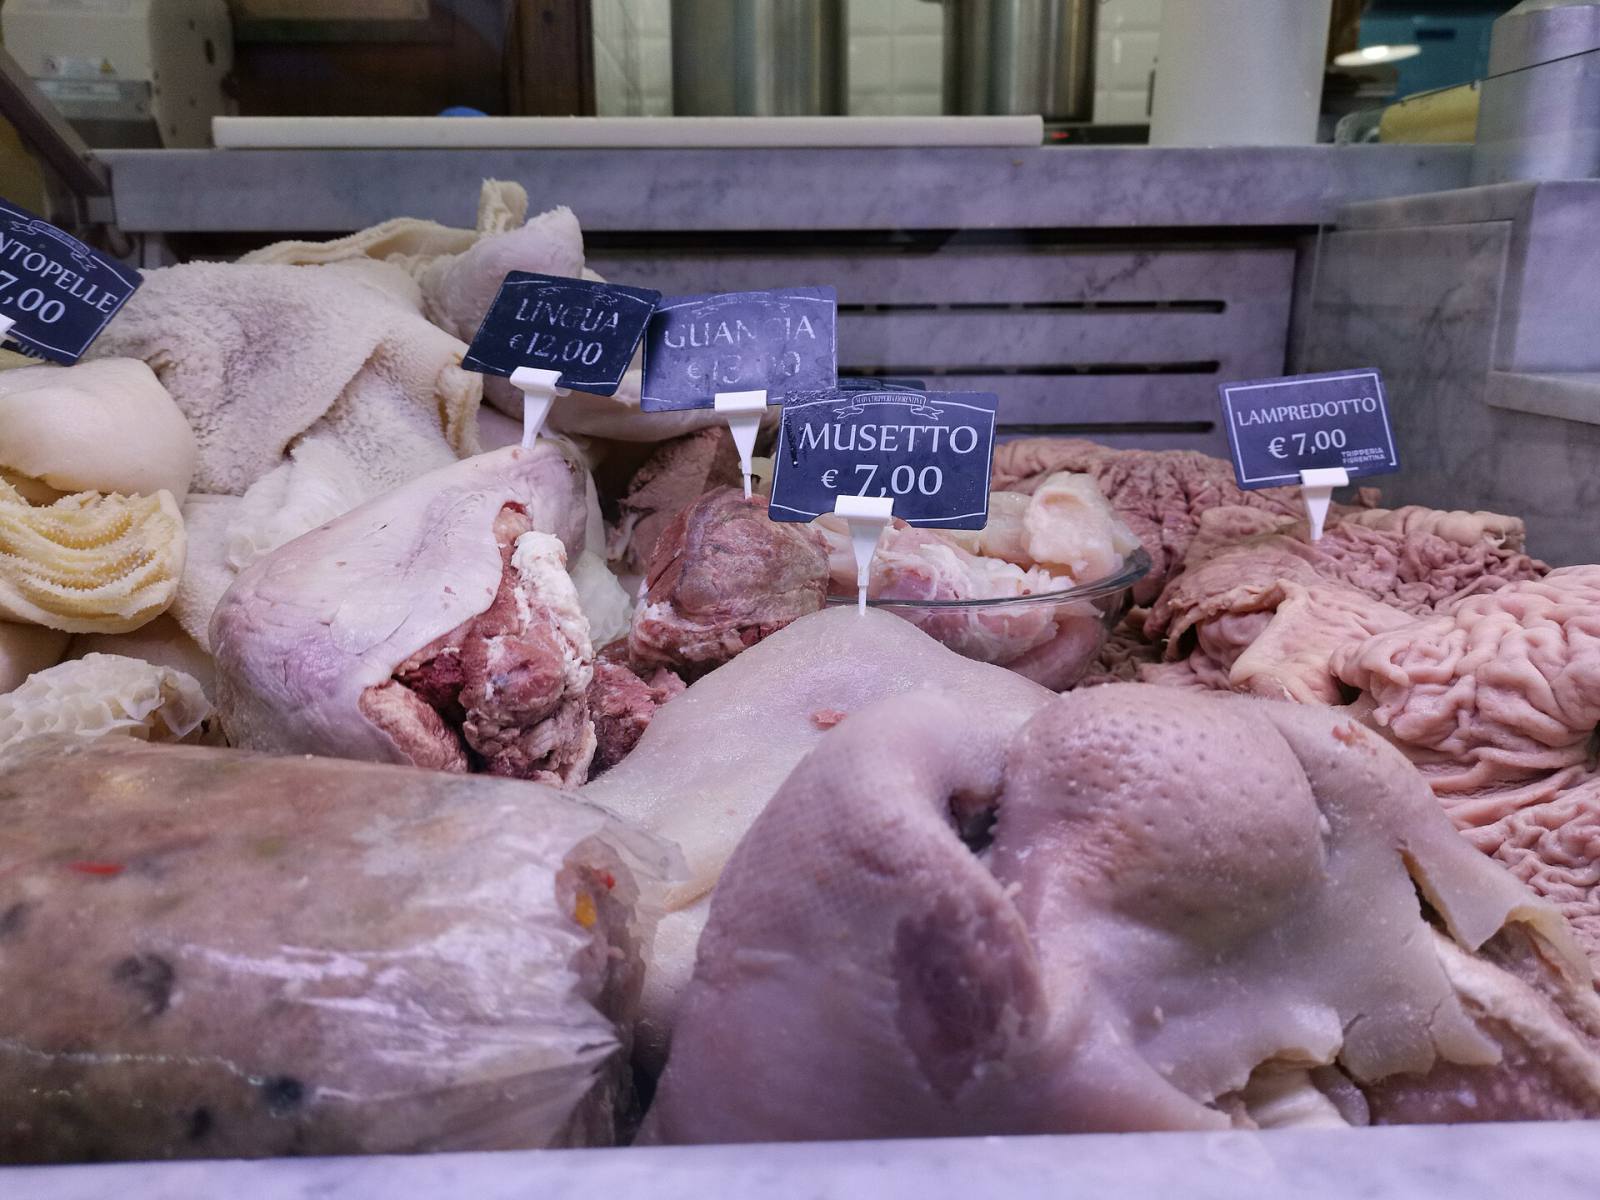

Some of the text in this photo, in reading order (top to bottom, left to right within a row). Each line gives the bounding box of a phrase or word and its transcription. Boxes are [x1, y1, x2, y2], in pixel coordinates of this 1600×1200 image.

[515, 298, 619, 335] LINGUA
[1237, 397, 1377, 427] LAMPREDOTTO
[798, 422, 979, 454] MUSETTO
[1267, 428, 1347, 459] € 7,00
[1341, 447, 1385, 458] TRIPPERIA
[820, 463, 944, 498] € 7,00
